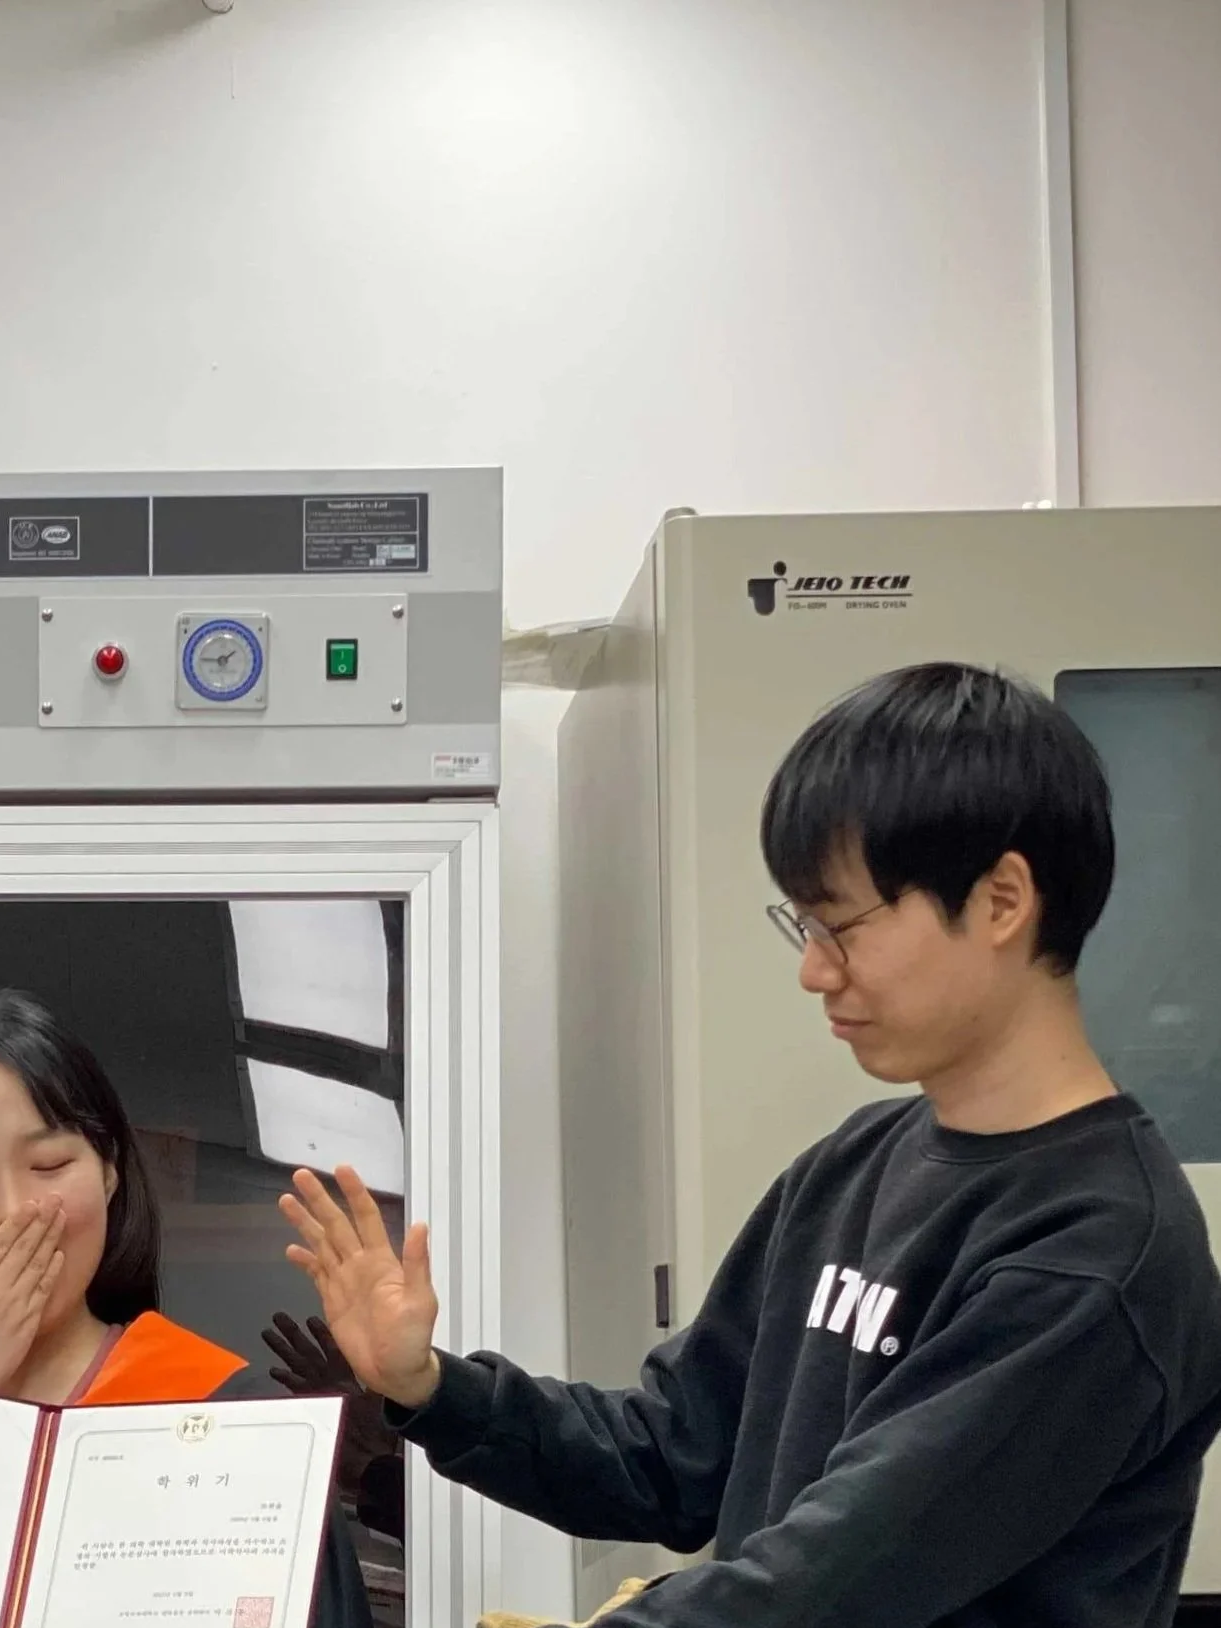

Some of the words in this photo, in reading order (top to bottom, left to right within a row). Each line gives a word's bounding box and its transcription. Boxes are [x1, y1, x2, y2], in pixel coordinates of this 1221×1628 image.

[850, 574, 911, 591] TECH
[845, 600, 880, 610] DRYING
[881, 599, 908, 609] OVEN
